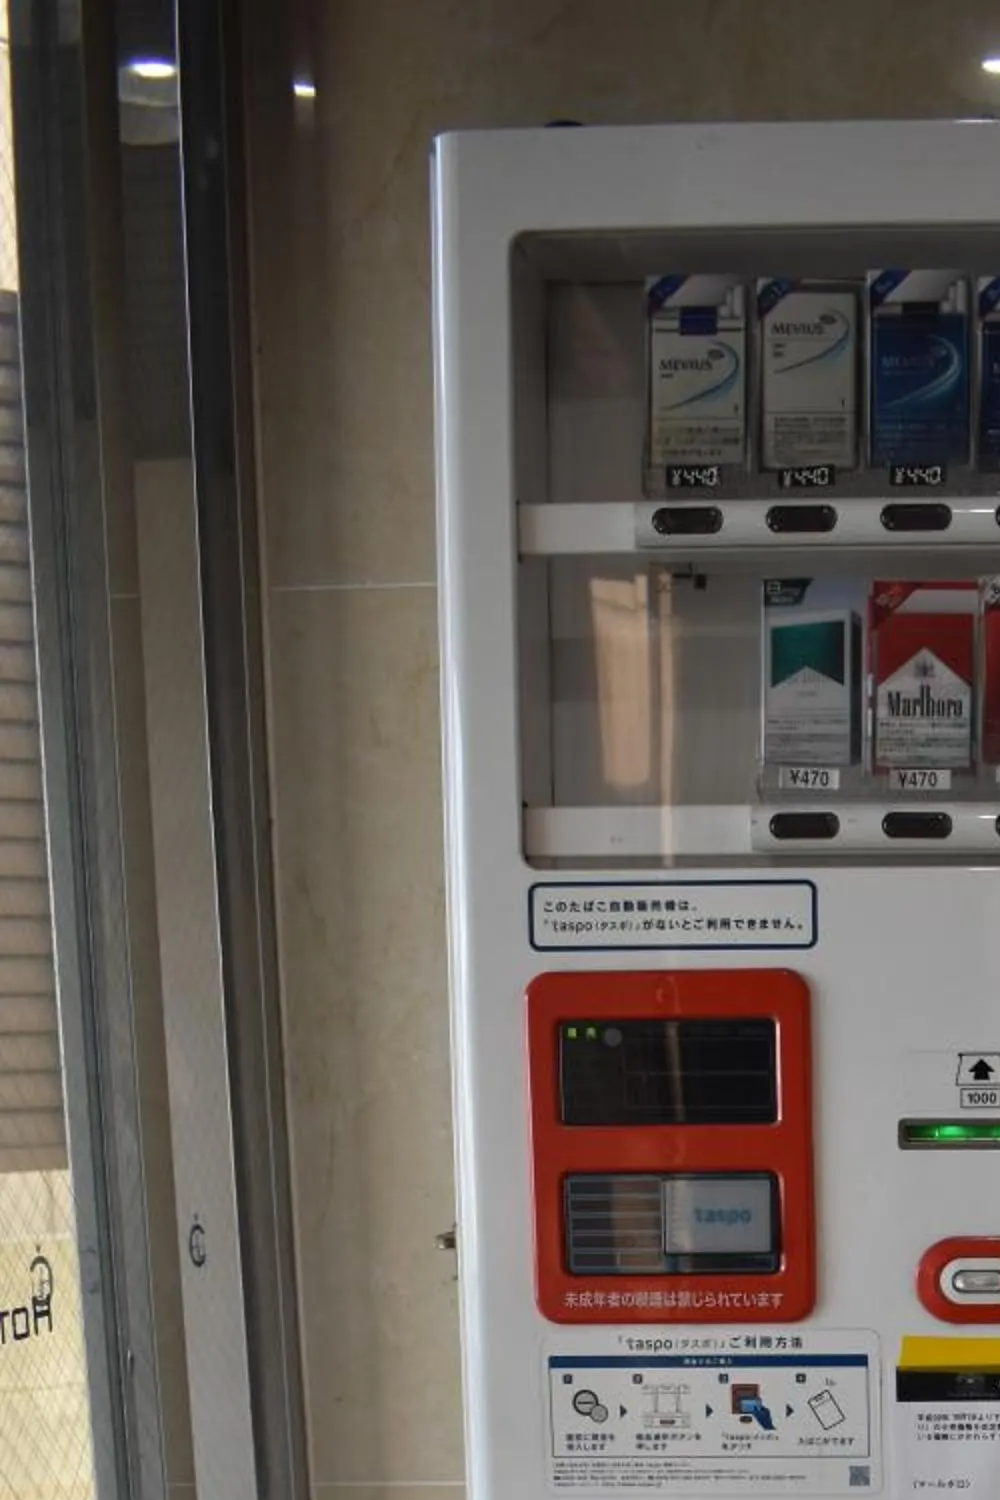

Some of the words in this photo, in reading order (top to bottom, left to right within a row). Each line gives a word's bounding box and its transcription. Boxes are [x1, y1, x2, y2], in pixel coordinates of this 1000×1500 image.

[895, 466, 942, 485] ¥440
[887, 685, 963, 718] Marlboro
[789, 770, 829, 787] ¥470
[899, 771, 937, 787] ¥470
[967, 1092, 998, 1104] 1000
[694, 1207, 752, 1226] taspo
[564, 1292, 784, 1309] 未成年者の喫煙は禁じられています
